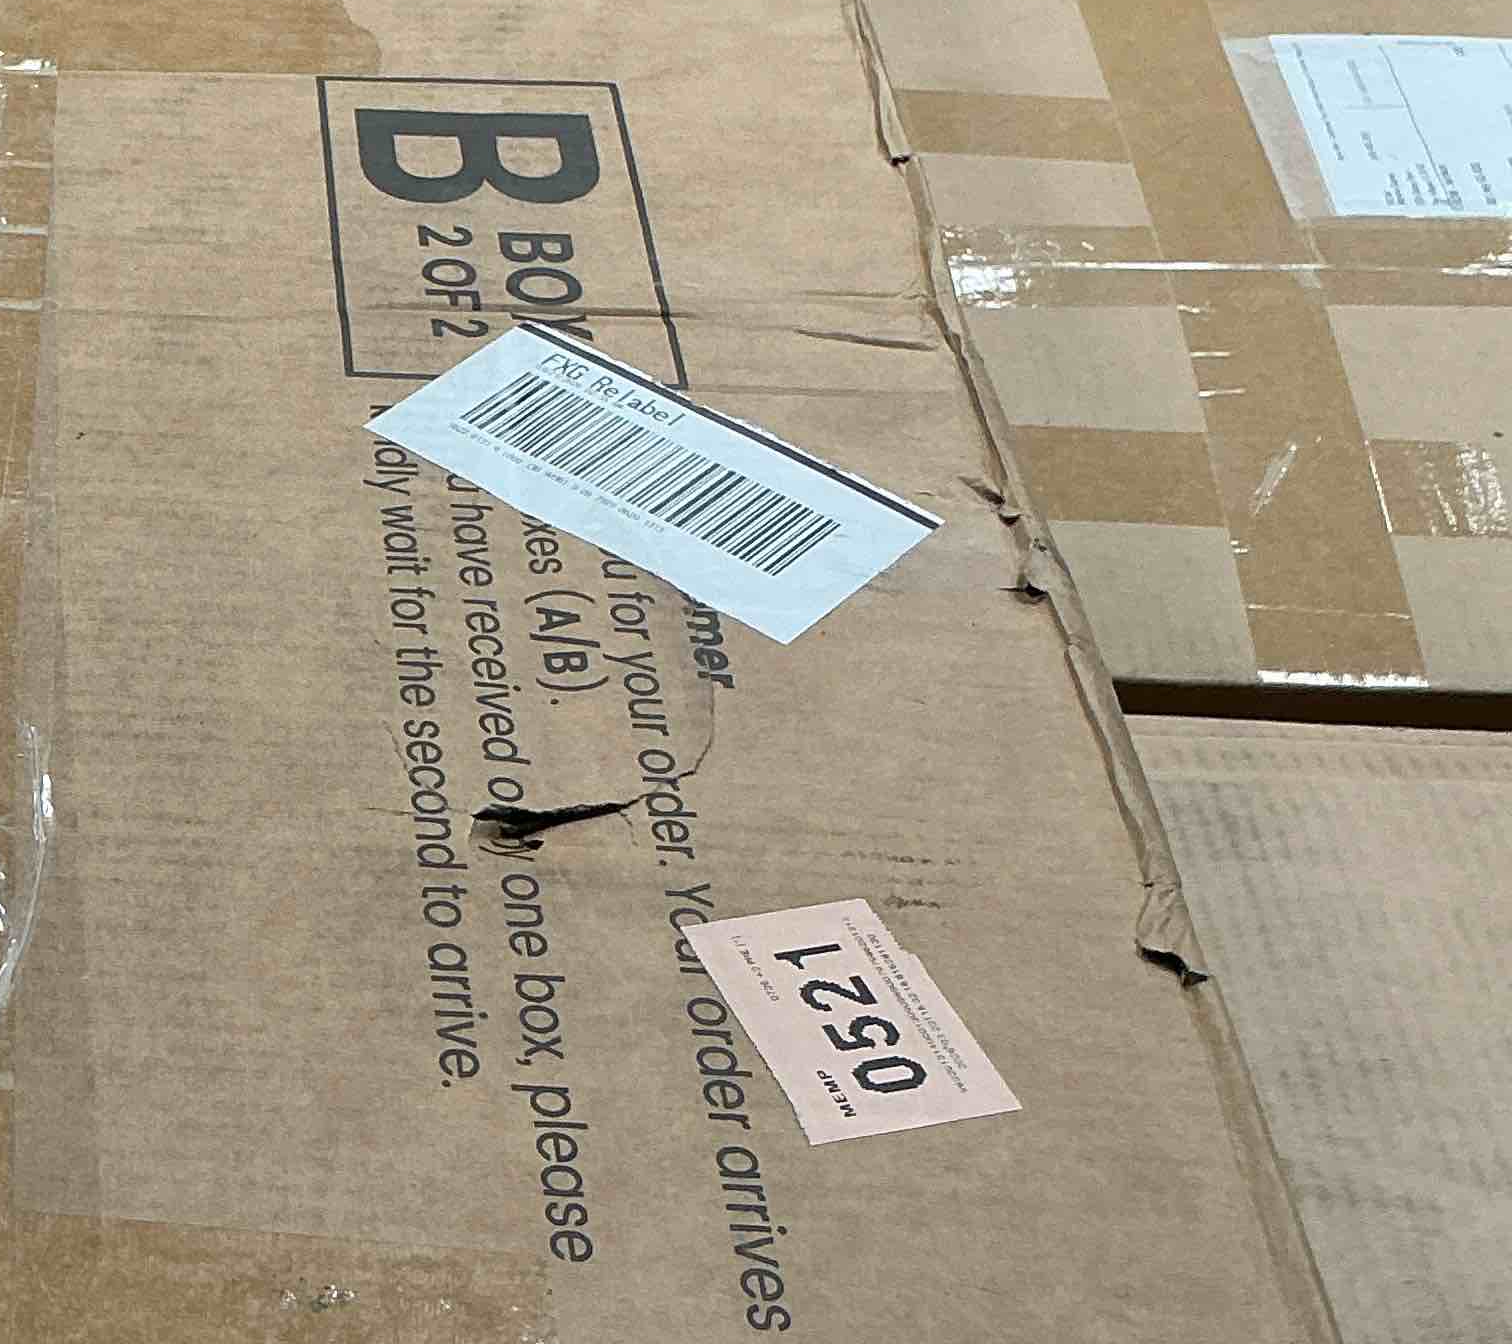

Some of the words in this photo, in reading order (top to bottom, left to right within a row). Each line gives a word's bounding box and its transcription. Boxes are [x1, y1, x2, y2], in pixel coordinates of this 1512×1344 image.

[354, 107, 602, 206] B
[418, 224, 474, 251] 2
[422, 261, 483, 313] OF
[496, 230, 594, 340] BOX
[430, 317, 490, 340] 2
[539, 352, 587, 386] FXG
[380, 506, 431, 576] wait
[448, 503, 495, 587] have
[520, 513, 564, 575] xes
[388, 586, 437, 635] for
[523, 589, 610, 707] (A/B).
[607, 591, 655, 642] for
[395, 647, 444, 707] the
[462, 598, 532, 765] received
[603, 651, 670, 736] your
[404, 716, 470, 869] second
[640, 749, 695, 868] order.
[421, 883, 471, 929] to
[501, 873, 548, 956] one
[426, 939, 489, 1089] arrive.
[513, 967, 567, 1068] box,
[773, 941, 928, 1095] 0521
[686, 995, 752, 1132] order
[815, 1068, 857, 1120] MEMP
[511, 1083, 596, 1265] please
[717, 1145, 792, 1333] arrives
